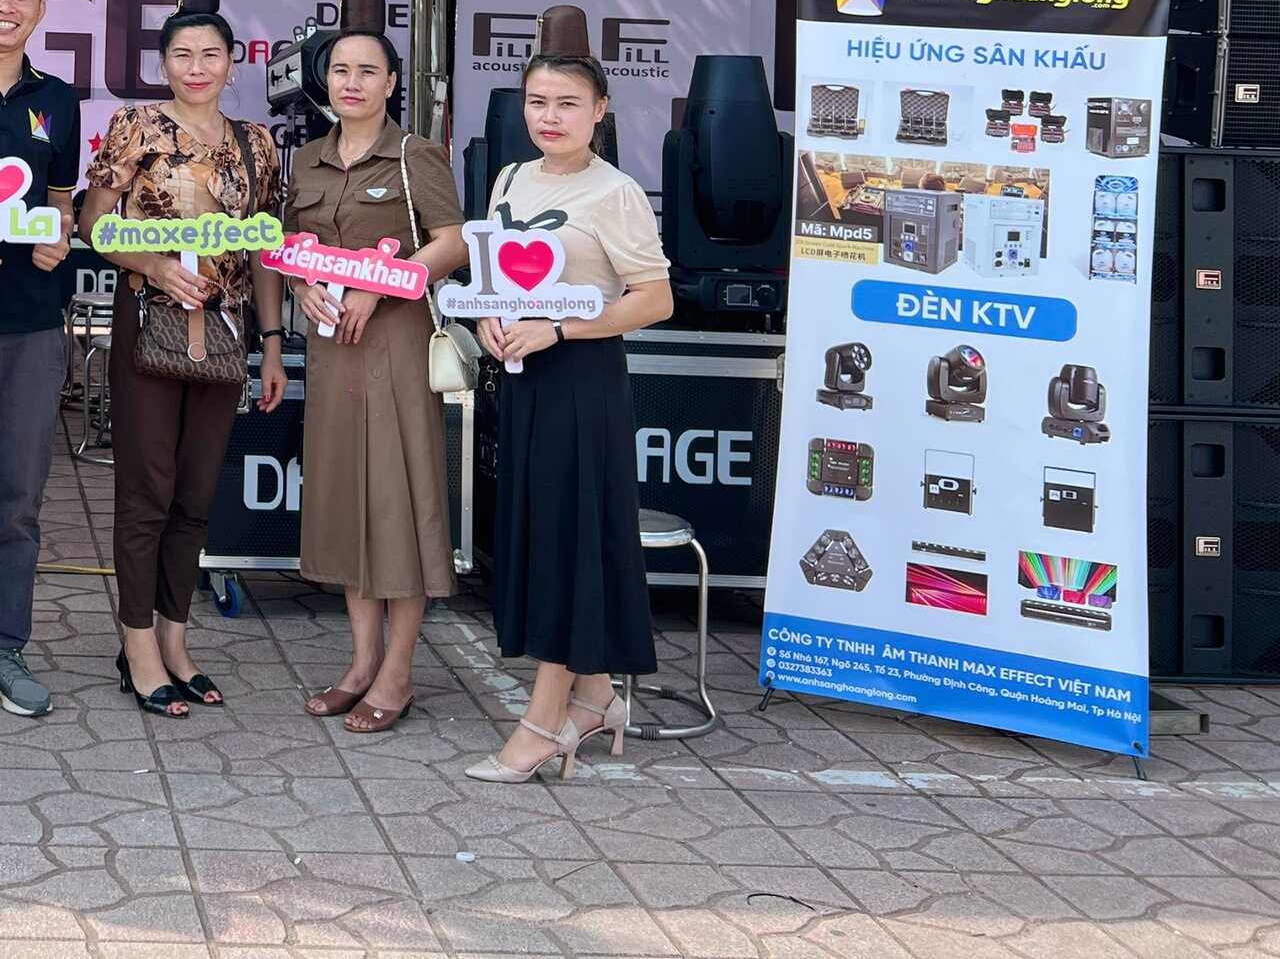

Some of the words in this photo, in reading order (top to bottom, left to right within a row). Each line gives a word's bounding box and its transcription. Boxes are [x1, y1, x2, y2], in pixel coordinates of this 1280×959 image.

[472, 60, 526, 73] acoust
[848, 36, 901, 64] HIỆU
[909, 39, 964, 63] ỨNG
[973, 43, 1025, 66] SÂN
[1034, 44, 1106, 70] KHẤU
[602, 65, 669, 79] acoustic
[9, 207, 54, 237] La
[98, 219, 277, 248] #maxeffect
[801, 223, 826, 236] Mã:
[830, 225, 872, 240] Mpd5
[471, 231, 497, 296] I
[76, 269, 117, 293] DA
[447, 295, 596, 316] #anhsanghoanglong
[896, 290, 961, 322] ĐÈN
[973, 302, 1036, 330] KTV
[636, 427, 753, 486] AGE
[768, 627, 812, 646] CÔNG
[816, 636, 833, 649] TY
[837, 639, 875, 656] TNHH
[882, 644, 905, 660] ÂM
[909, 651, 959, 671] THANH
[963, 661, 996, 678] MAX
[1000, 667, 1054, 689] EFFECT
[1058, 678, 1091, 697] VIỆT
[1095, 685, 1132, 703] NAM
[777, 673, 917, 703] www.anhsanghoanglong.com
